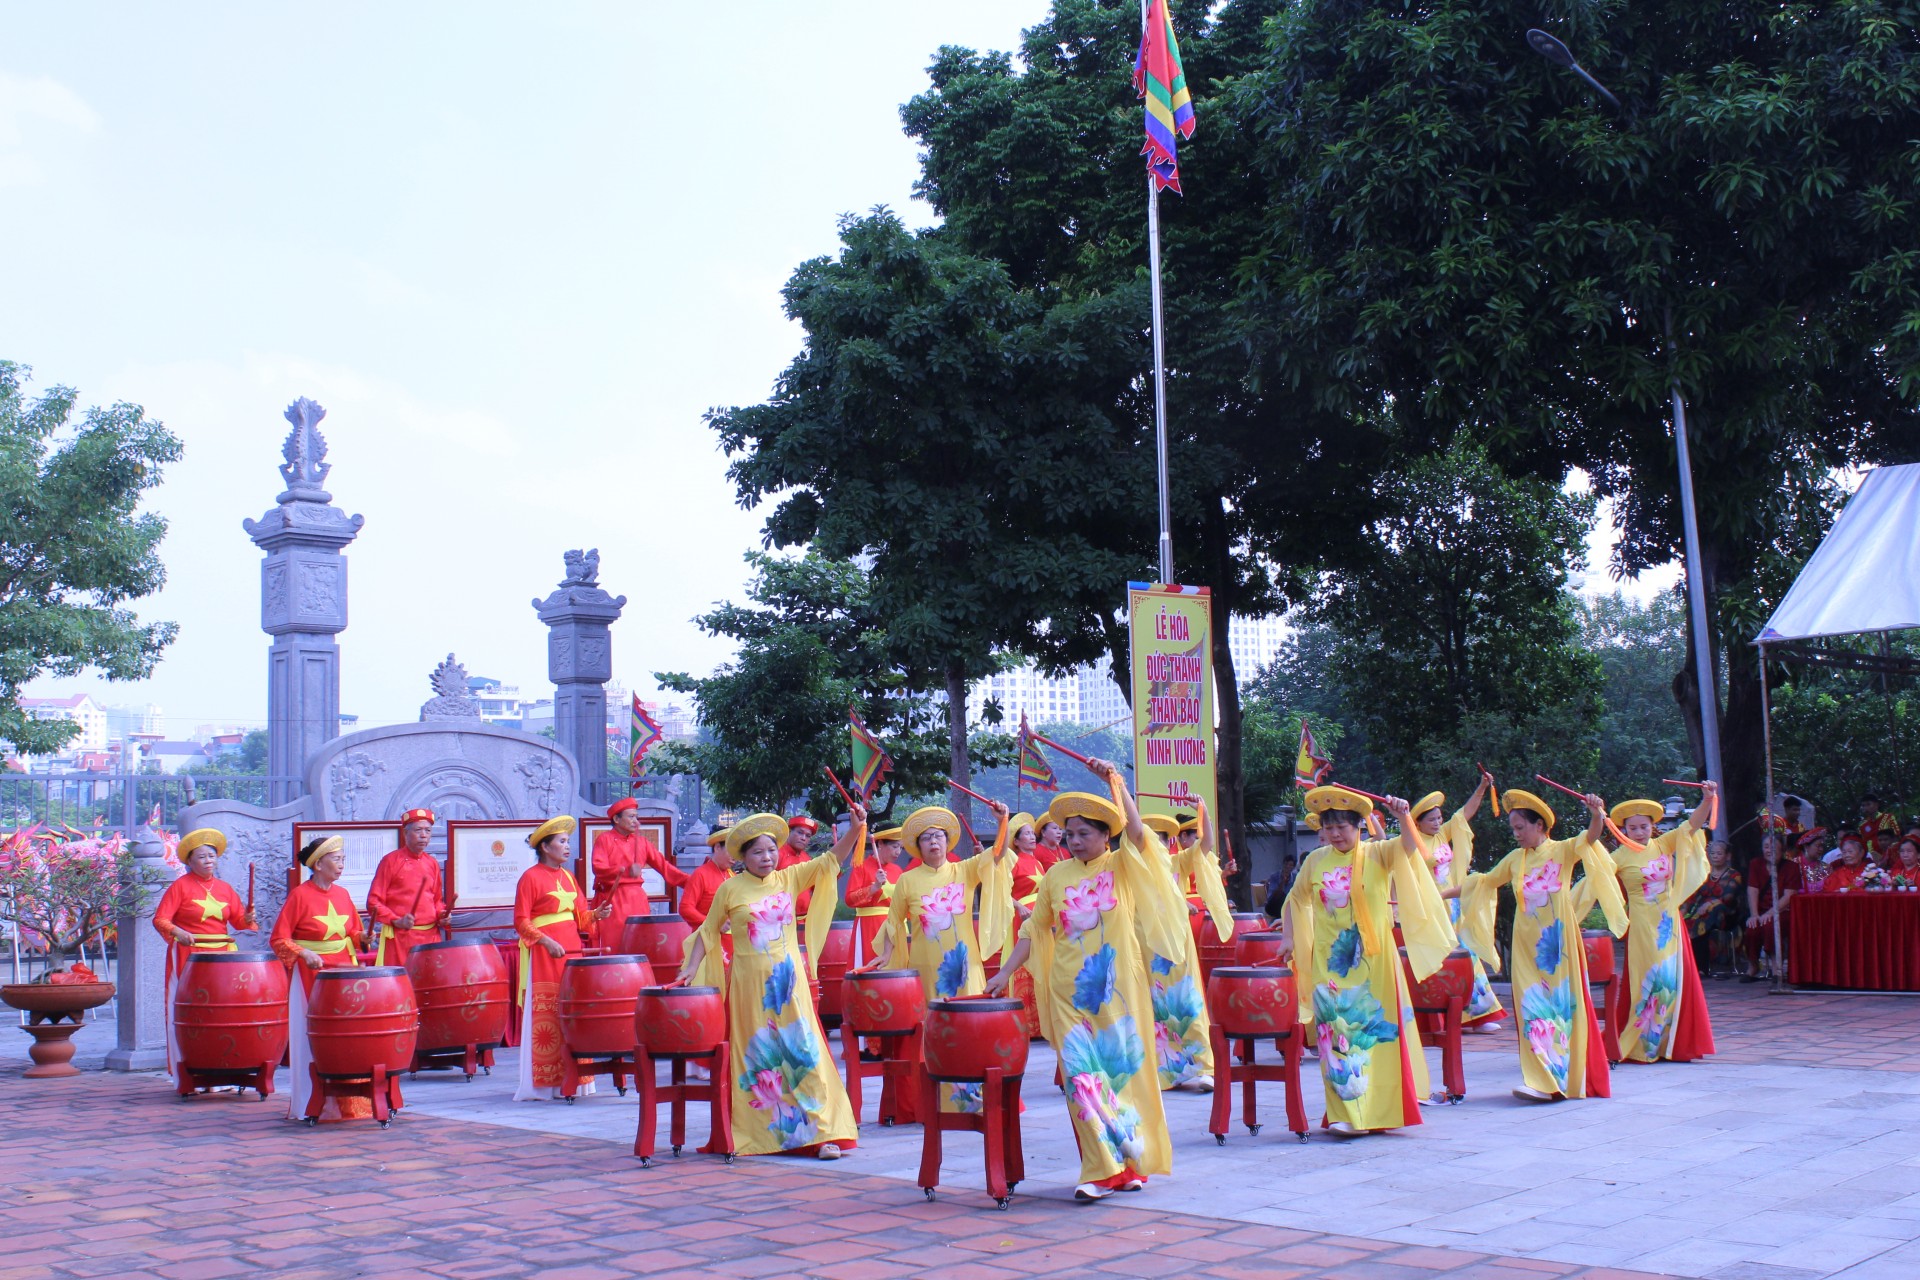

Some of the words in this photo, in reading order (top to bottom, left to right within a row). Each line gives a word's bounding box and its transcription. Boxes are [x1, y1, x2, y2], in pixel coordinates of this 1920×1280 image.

[1156, 605, 1167, 640] LỄ
[1170, 610, 1190, 641] HÓA
[1146, 650, 1167, 682] ĐỨC
[1169, 651, 1202, 683] THÁNH
[1180, 689, 1200, 724] BẢO
[1146, 739, 1172, 765] NINH
[1174, 738, 1206, 766] VƯƠNG
